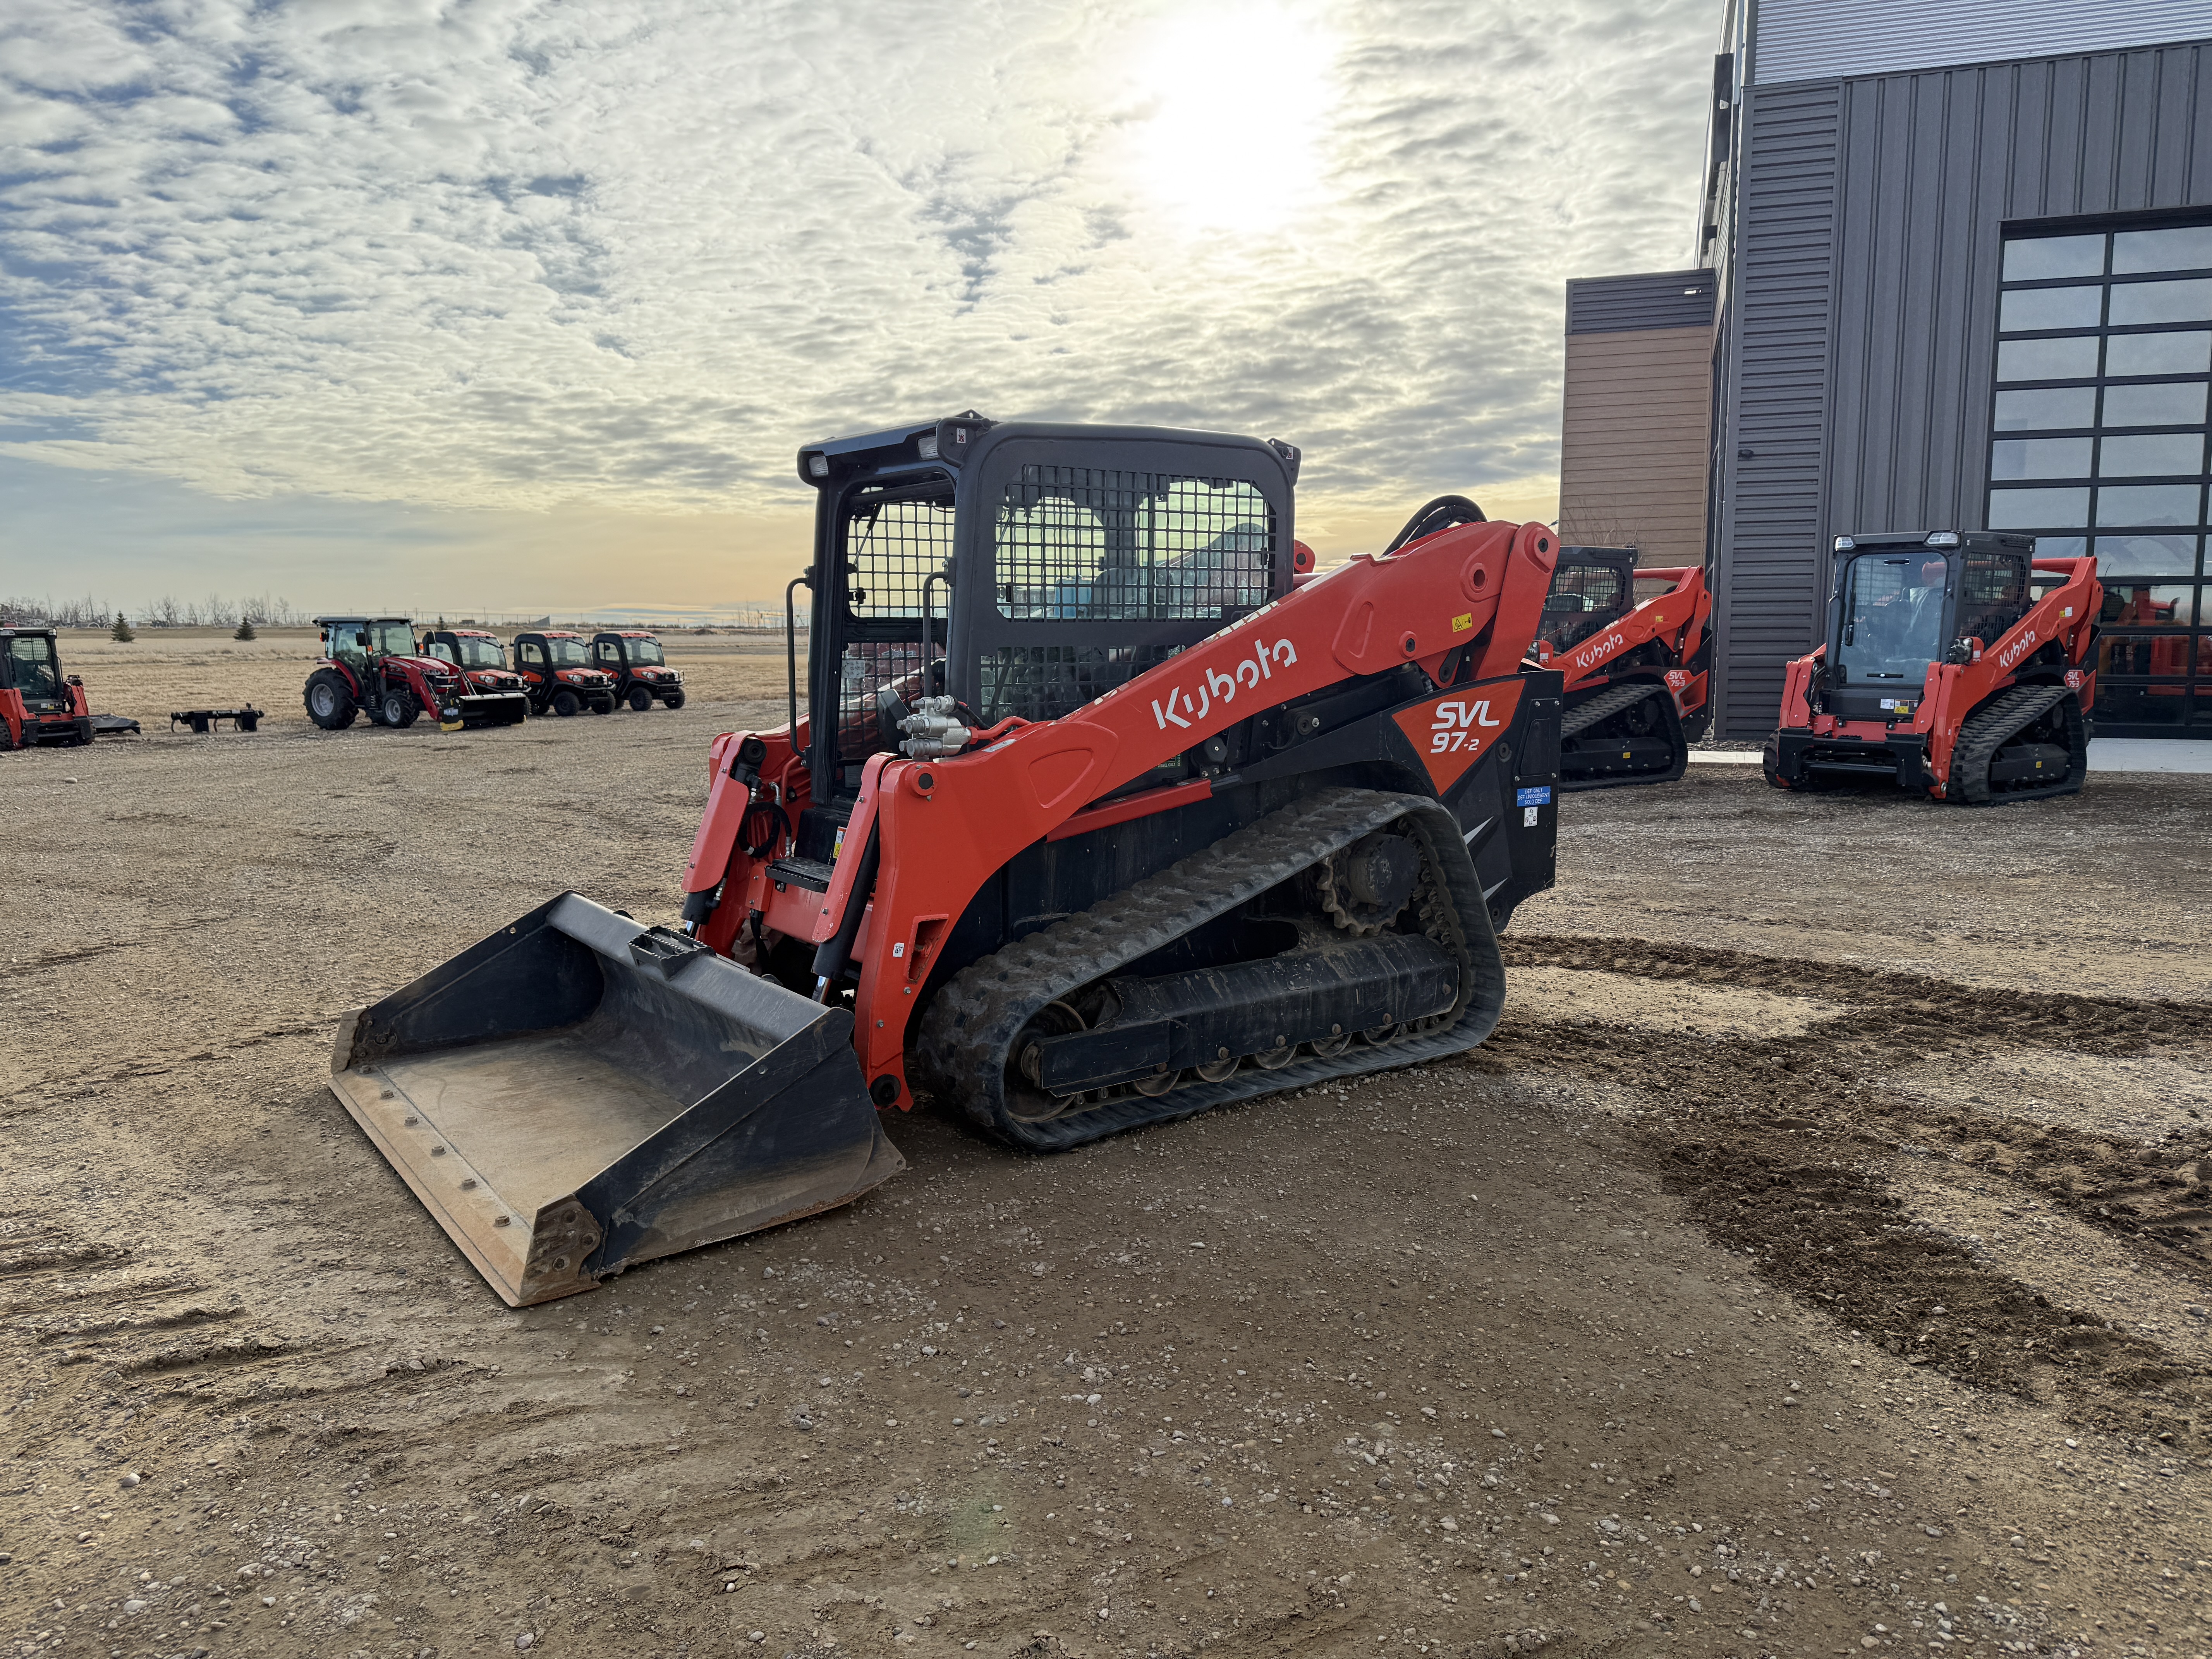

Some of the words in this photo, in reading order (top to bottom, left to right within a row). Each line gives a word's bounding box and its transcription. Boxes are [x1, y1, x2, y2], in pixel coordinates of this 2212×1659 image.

[1576, 634, 1623, 668] Kubota
[1999, 630, 2035, 667] Kubota
[1151, 639, 1298, 730] Kubota
[2067, 672, 2080, 680] SVL
[1431, 700, 1499, 729] SVL
[1430, 731, 1480, 754] 97-2
